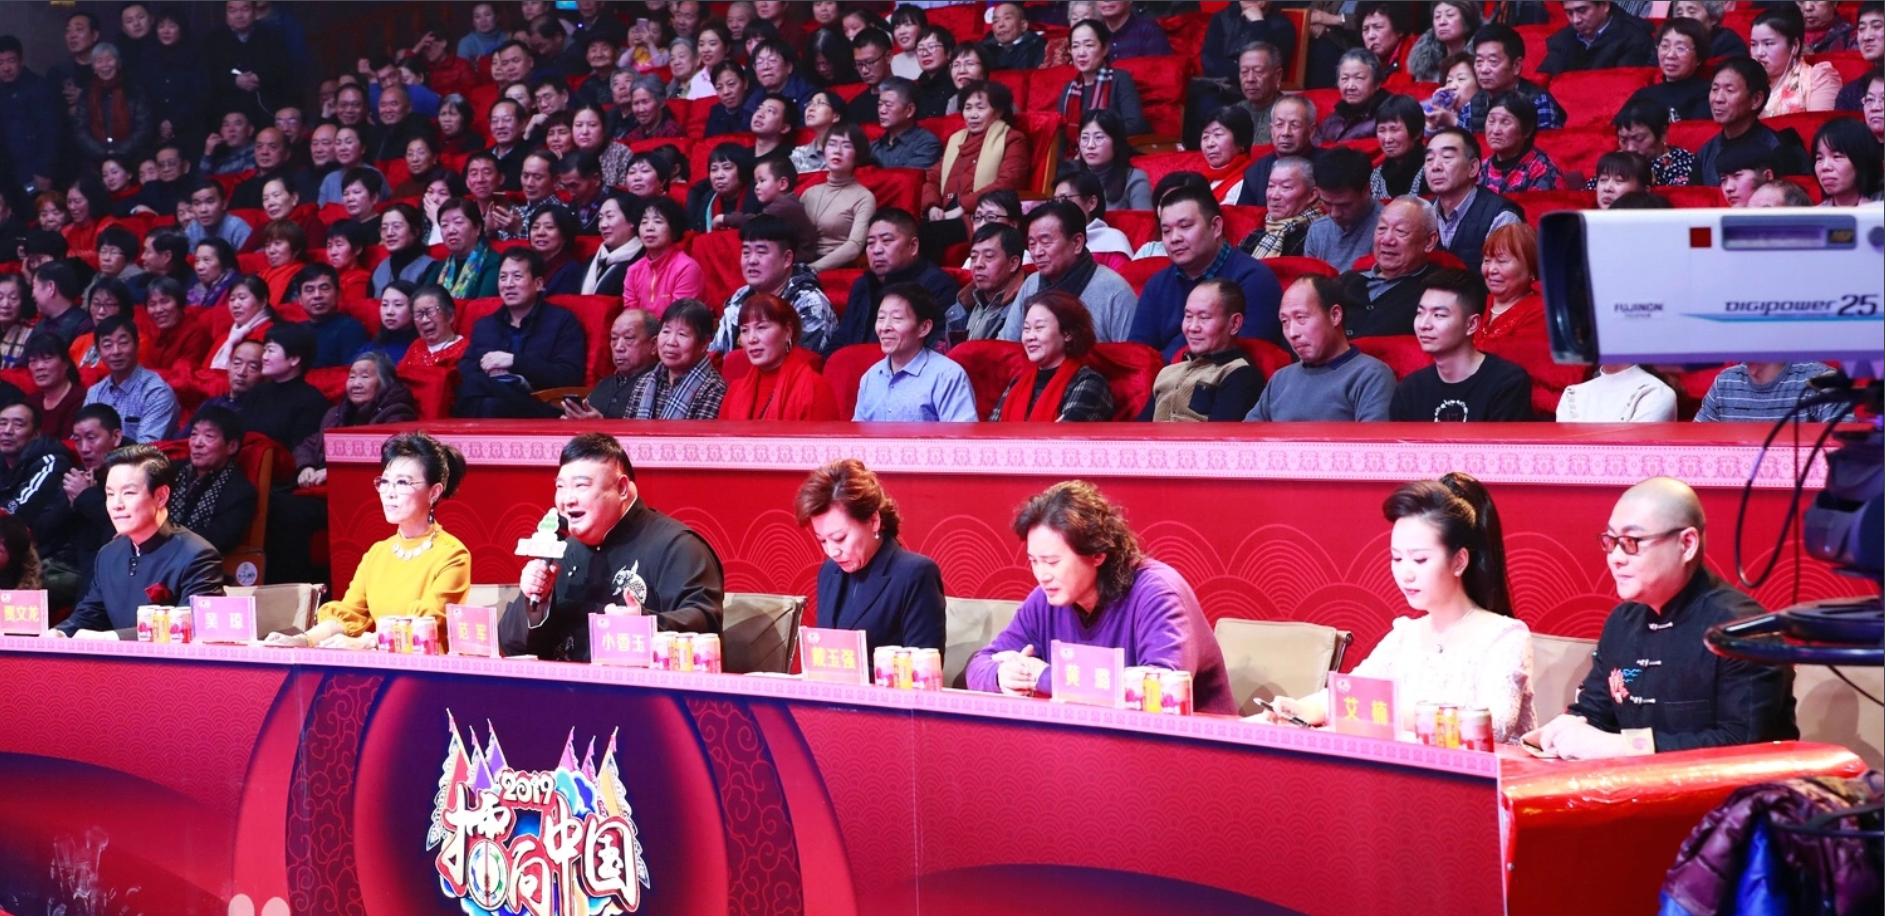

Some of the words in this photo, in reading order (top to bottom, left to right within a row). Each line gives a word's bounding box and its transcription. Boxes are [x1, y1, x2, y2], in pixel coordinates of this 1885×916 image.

[1837, 294, 1878, 316] 25
[601, 632, 646, 653] 小香玉
[811, 647, 856, 669] 戴玉强
[501, 774, 554, 804] 2019
